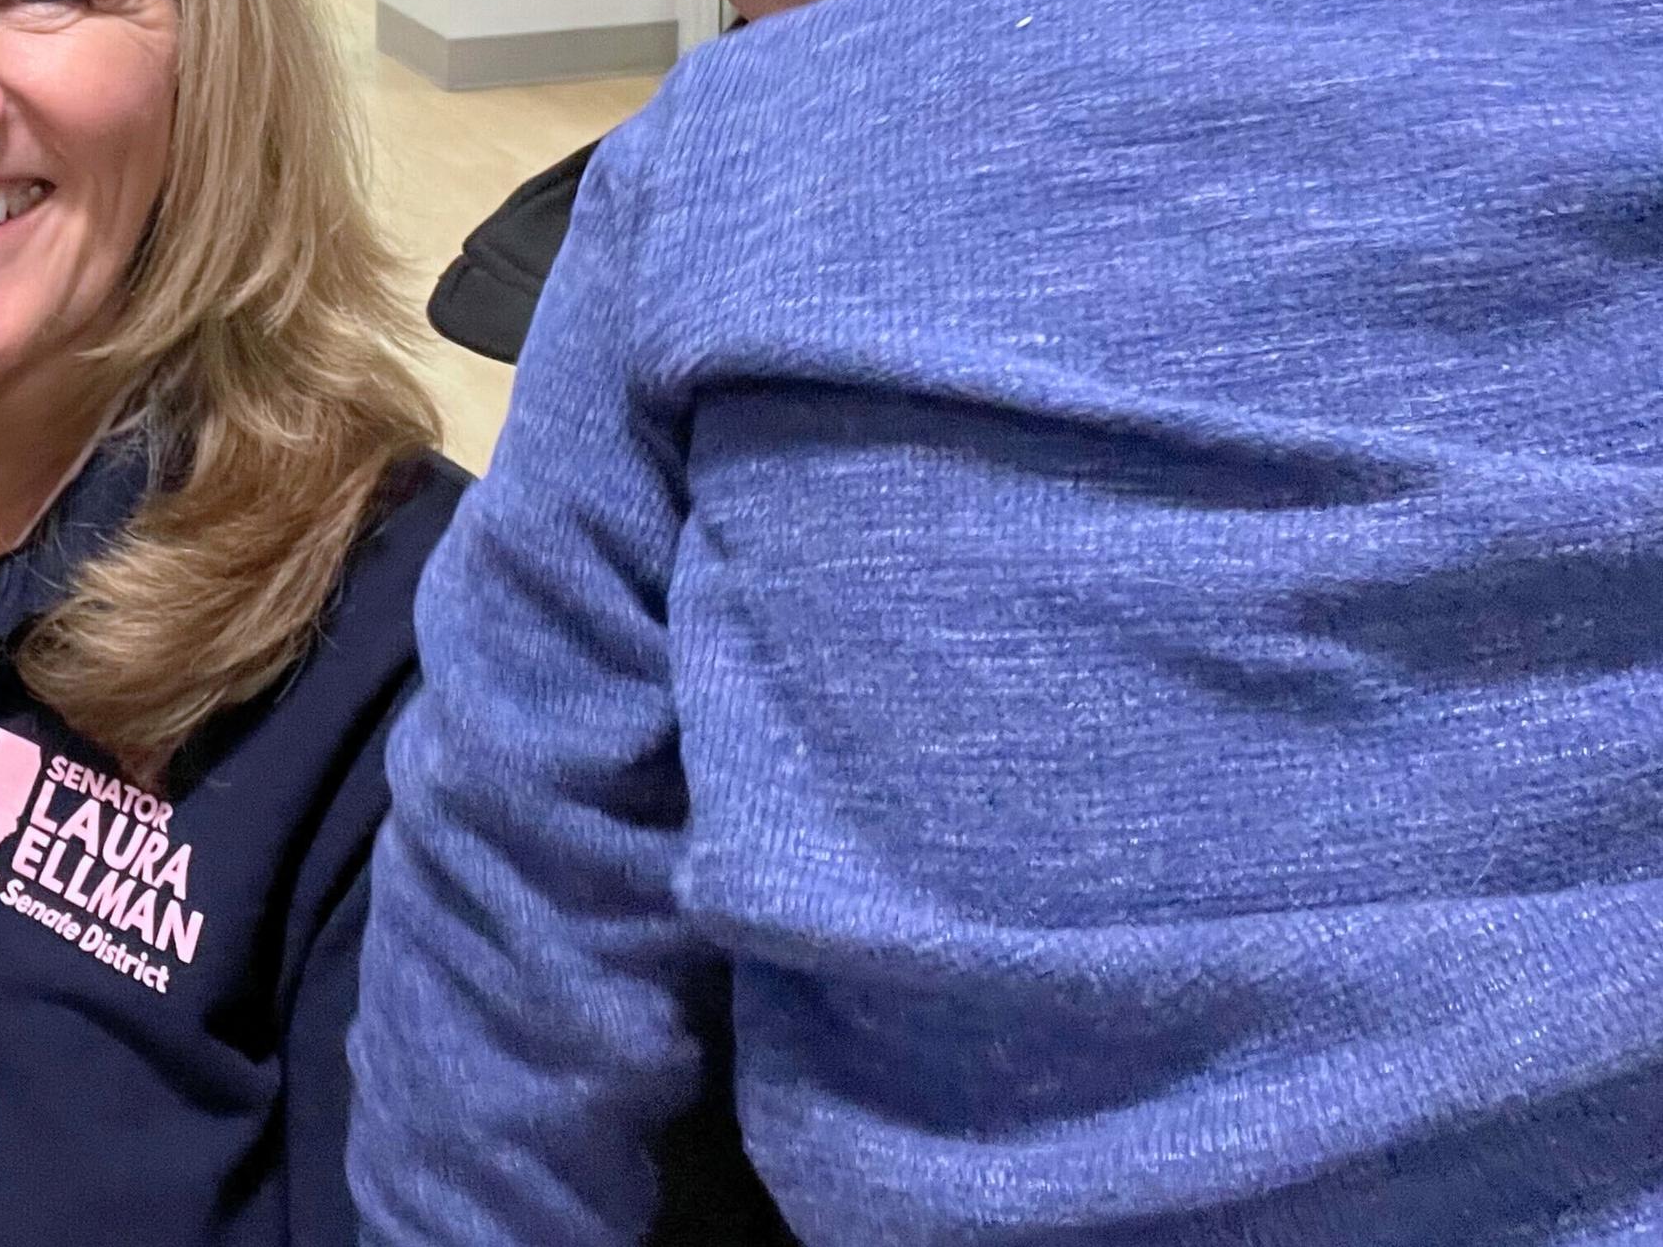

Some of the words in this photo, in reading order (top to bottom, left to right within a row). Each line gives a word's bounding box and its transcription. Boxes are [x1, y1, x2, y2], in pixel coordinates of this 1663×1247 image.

[30, 780, 192, 900] LAURA
[46, 755, 173, 833] SENATOR
[0, 879, 80, 940] Senate
[78, 924, 170, 993] District
[11, 825, 204, 963] ELLMAN
